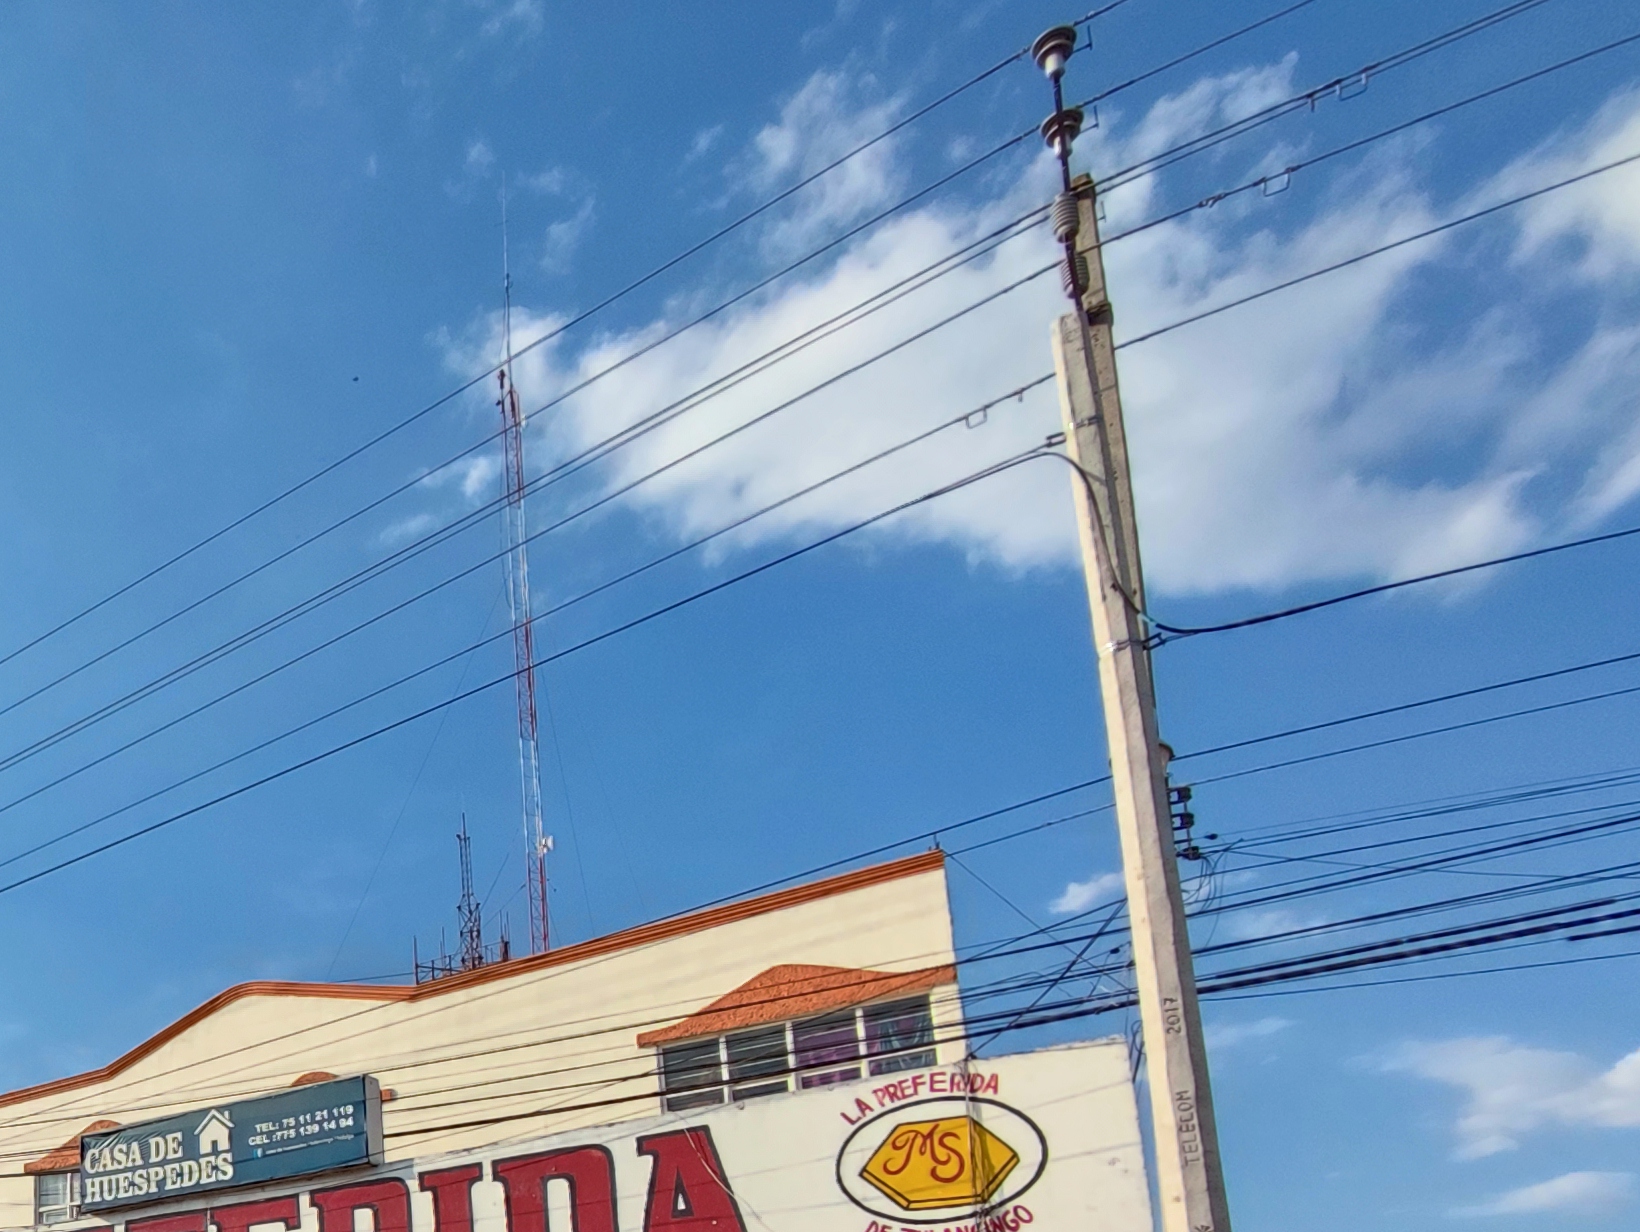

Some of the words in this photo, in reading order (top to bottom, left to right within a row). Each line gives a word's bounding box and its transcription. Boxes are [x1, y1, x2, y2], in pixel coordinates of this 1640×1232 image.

[1163, 997, 1182, 1034] 2017
[841, 1097, 874, 1125] LA
[1175, 1090, 1200, 1167] TELECOM
[84, 1142, 143, 1174] CASA
[149, 1132, 183, 1163] DE
[84, 1153, 234, 1204] HUESPEDES
